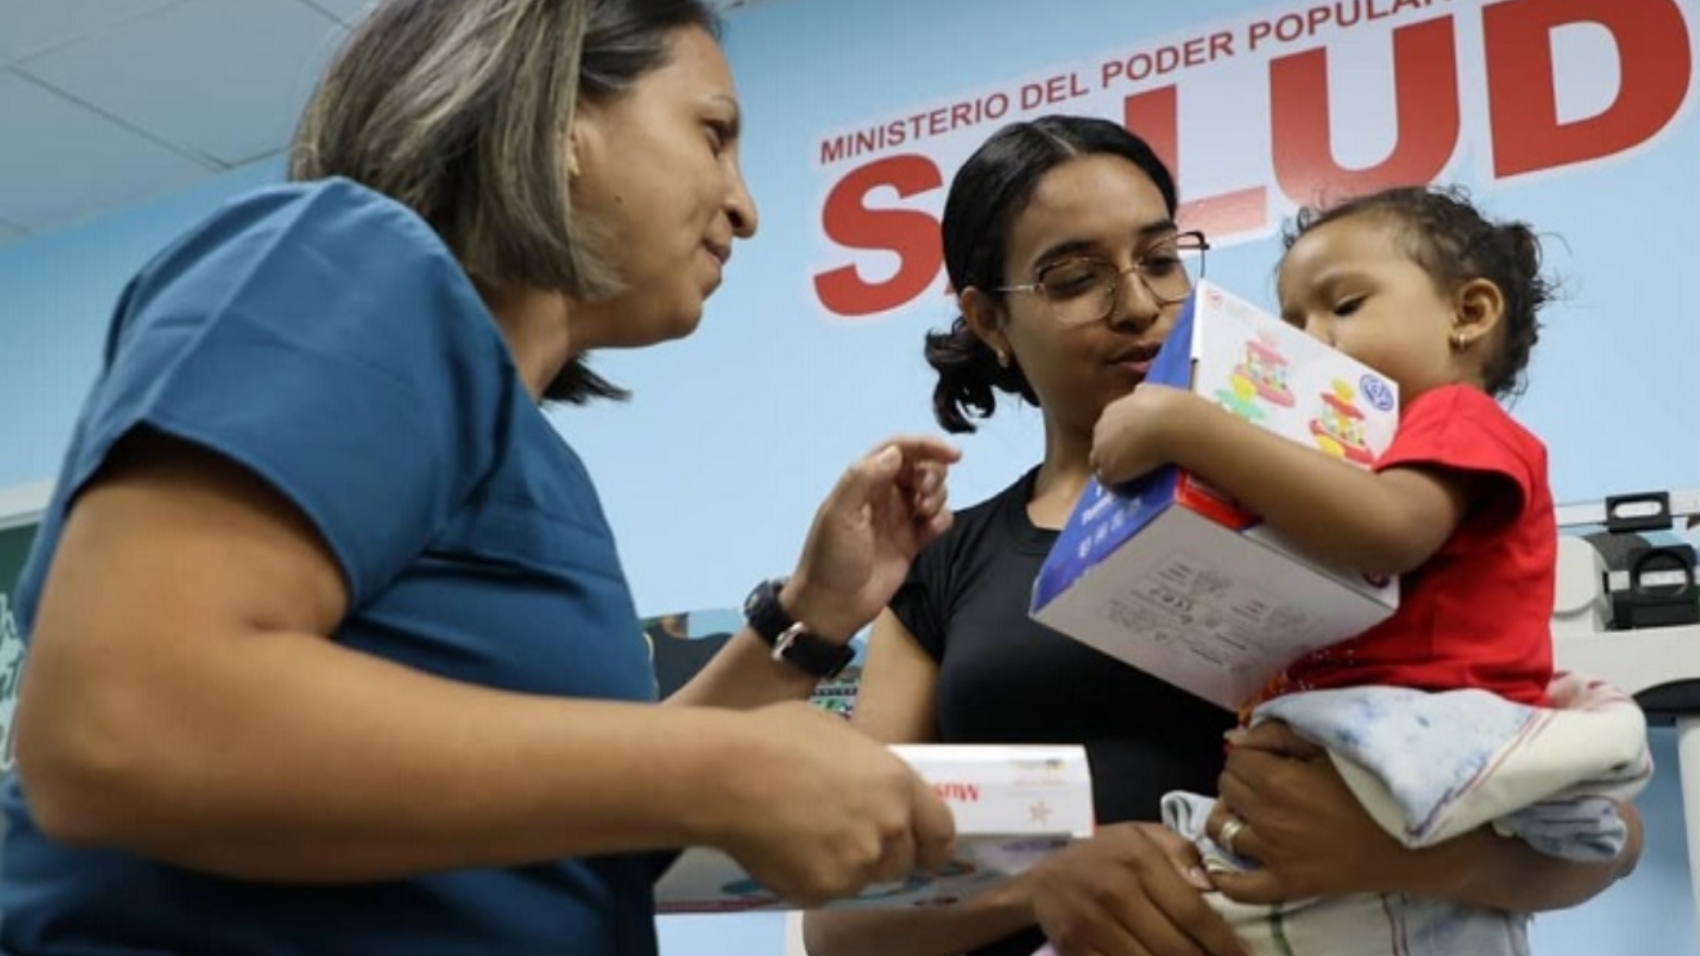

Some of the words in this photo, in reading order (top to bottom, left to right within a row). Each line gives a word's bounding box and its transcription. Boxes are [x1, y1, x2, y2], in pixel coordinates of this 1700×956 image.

[813, 0, 1692, 317] SLUD
[819, 93, 1010, 164] MINISTERIO
[1020, 72, 1089, 111] DEL
[1102, 31, 1236, 89] PODER
